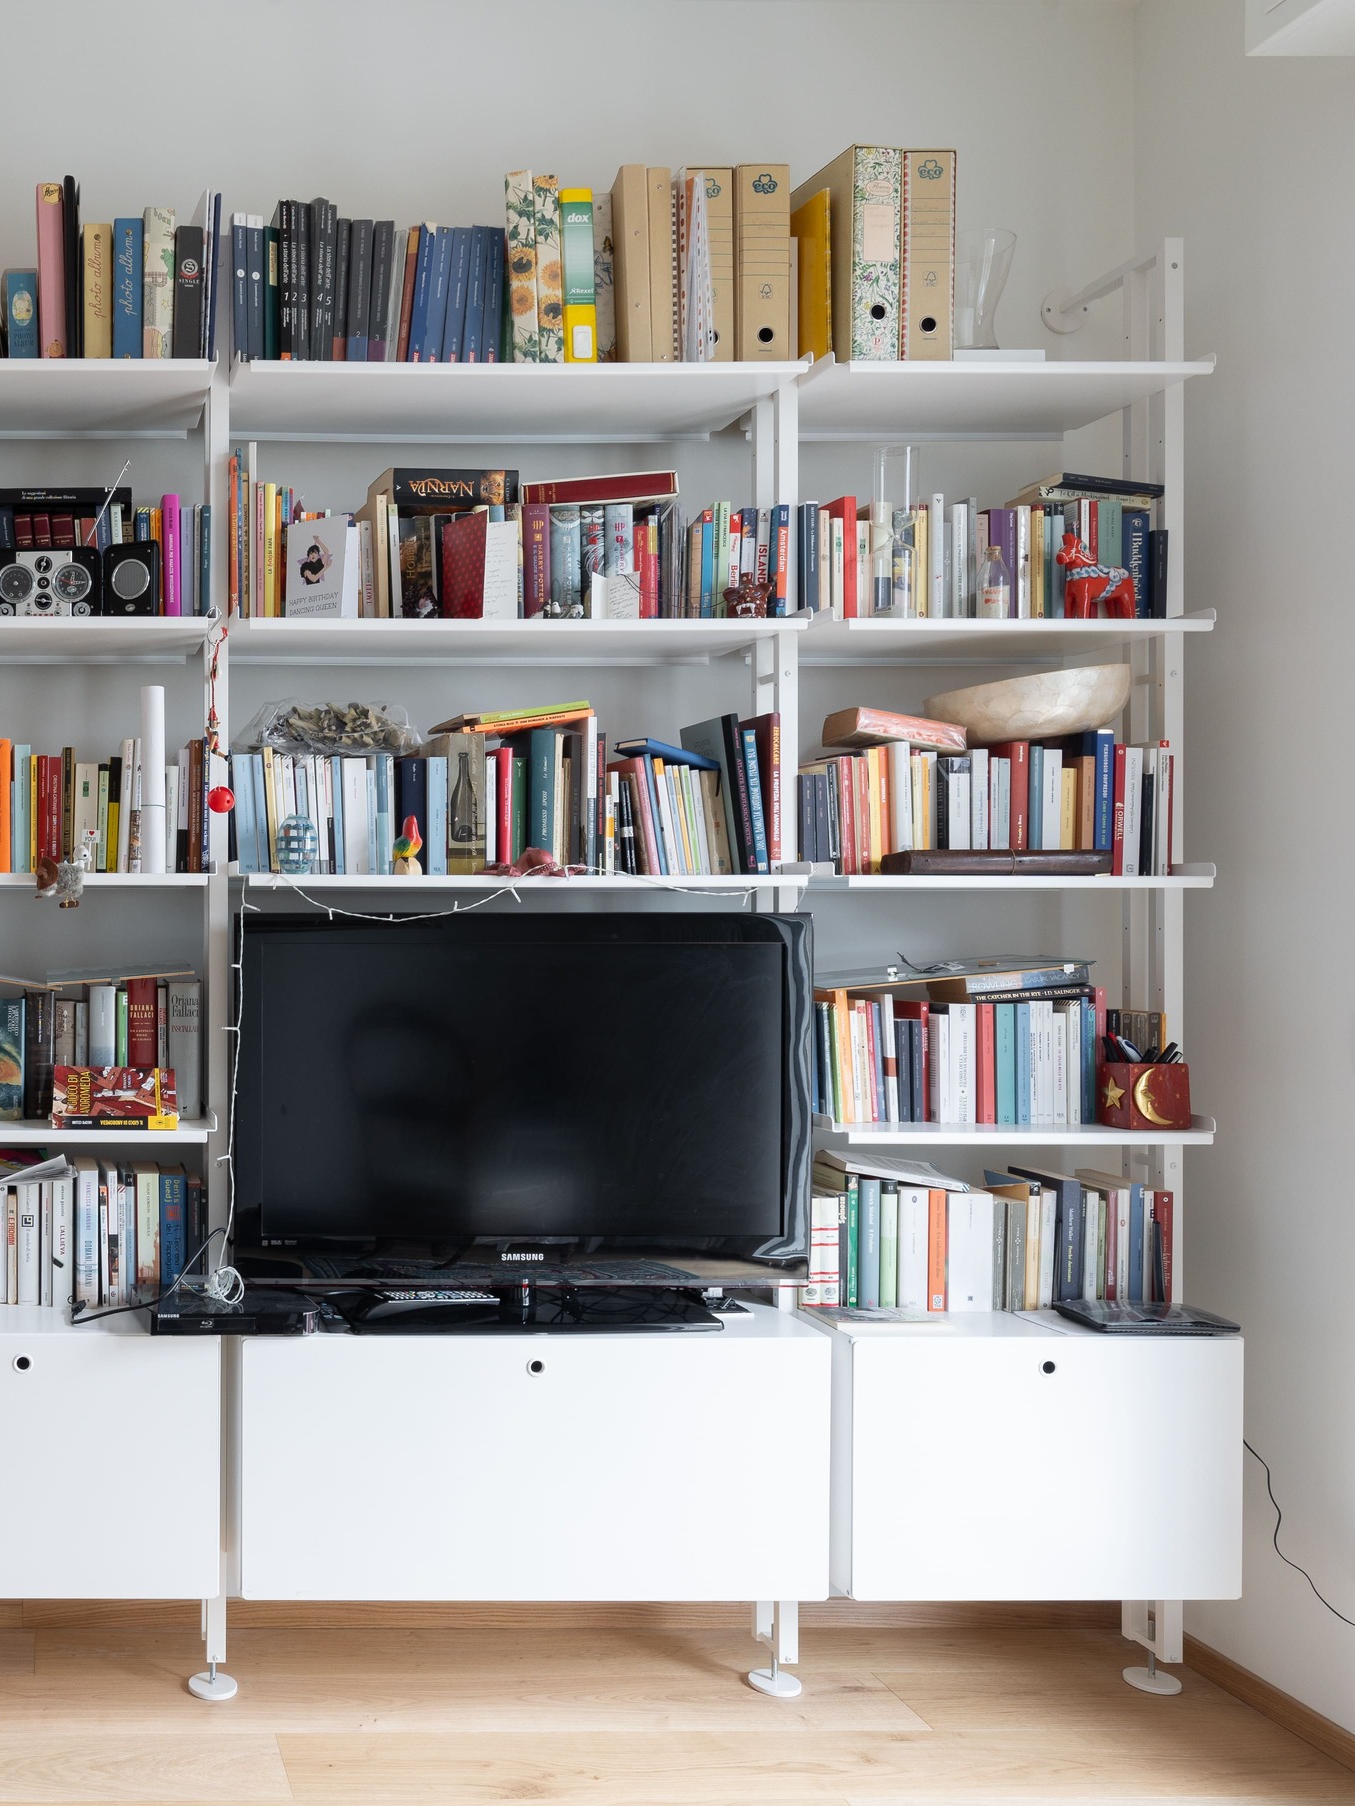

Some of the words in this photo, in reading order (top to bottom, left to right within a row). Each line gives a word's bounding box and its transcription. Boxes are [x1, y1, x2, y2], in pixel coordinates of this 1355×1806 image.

[920, 168, 942, 177] eco
[755, 182, 777, 191] eco
[567, 213, 589, 224] dox
[86, 282, 102, 319] photo
[118, 278, 135, 316] photo
[283, 292, 290, 302] 1
[779, 528, 787, 573] Amsterdam
[309, 592, 339, 603] BIRTHDAY
[315, 602, 338, 611] QUEEN
[739, 792, 747, 820] BOTANICA
[743, 822, 751, 846] POETICA
[1116, 810, 1124, 840] ORWELL
[987, 992, 1013, 1001] CATCHER
[1021, 991, 1031, 999] THE
[1031, 990, 1042, 998] RYE
[1054, 988, 1081, 997] SALINGER
[79, 1071, 90, 1115] ANDROMEDA
[165, 1240, 173, 1278] Pappagallo
[501, 1253, 544, 1261] SAMSUNG
